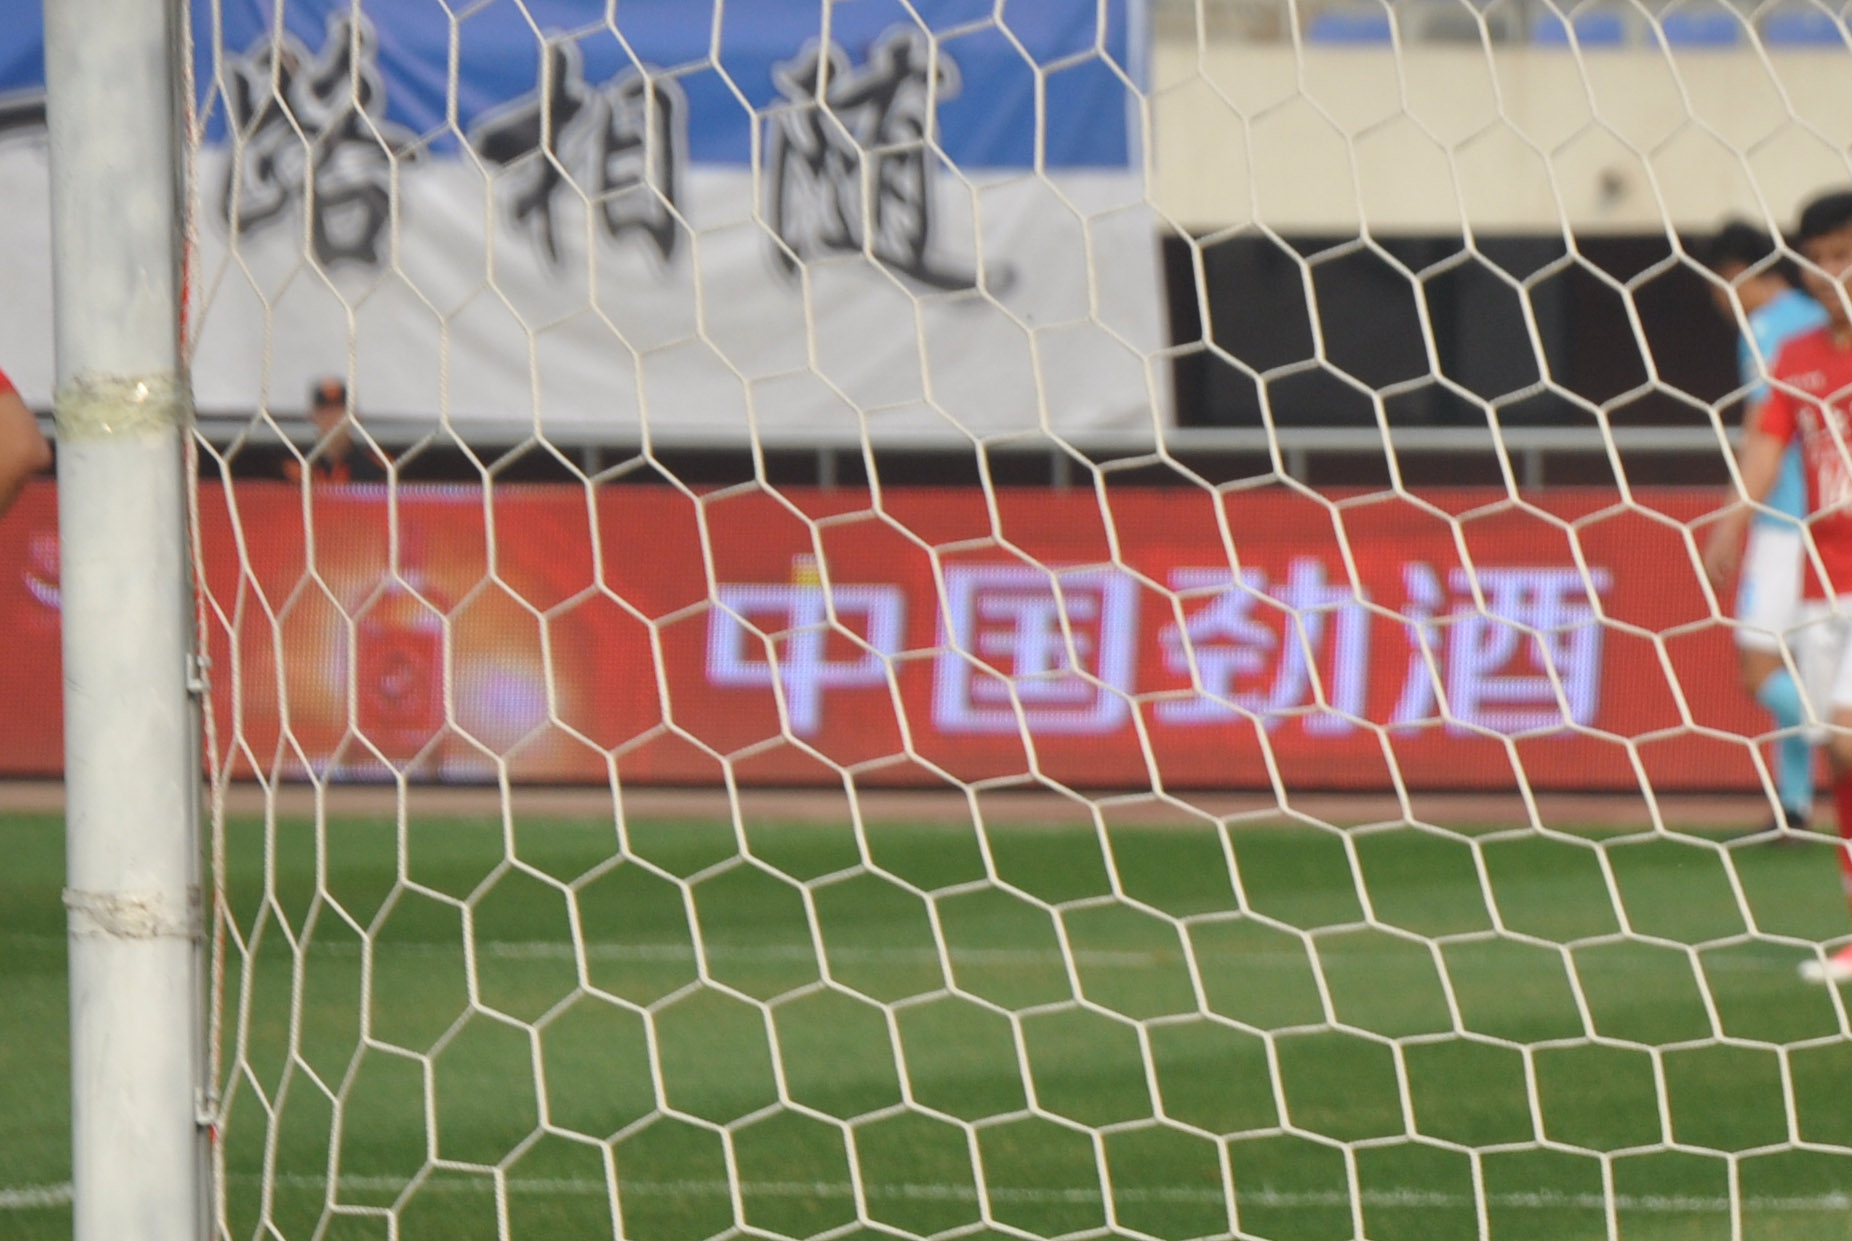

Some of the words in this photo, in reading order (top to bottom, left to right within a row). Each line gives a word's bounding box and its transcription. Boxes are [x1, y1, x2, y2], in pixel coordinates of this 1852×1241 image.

[0, 12, 1016, 292] 路相随
[706, 553, 1614, 736] 中国劲酒
